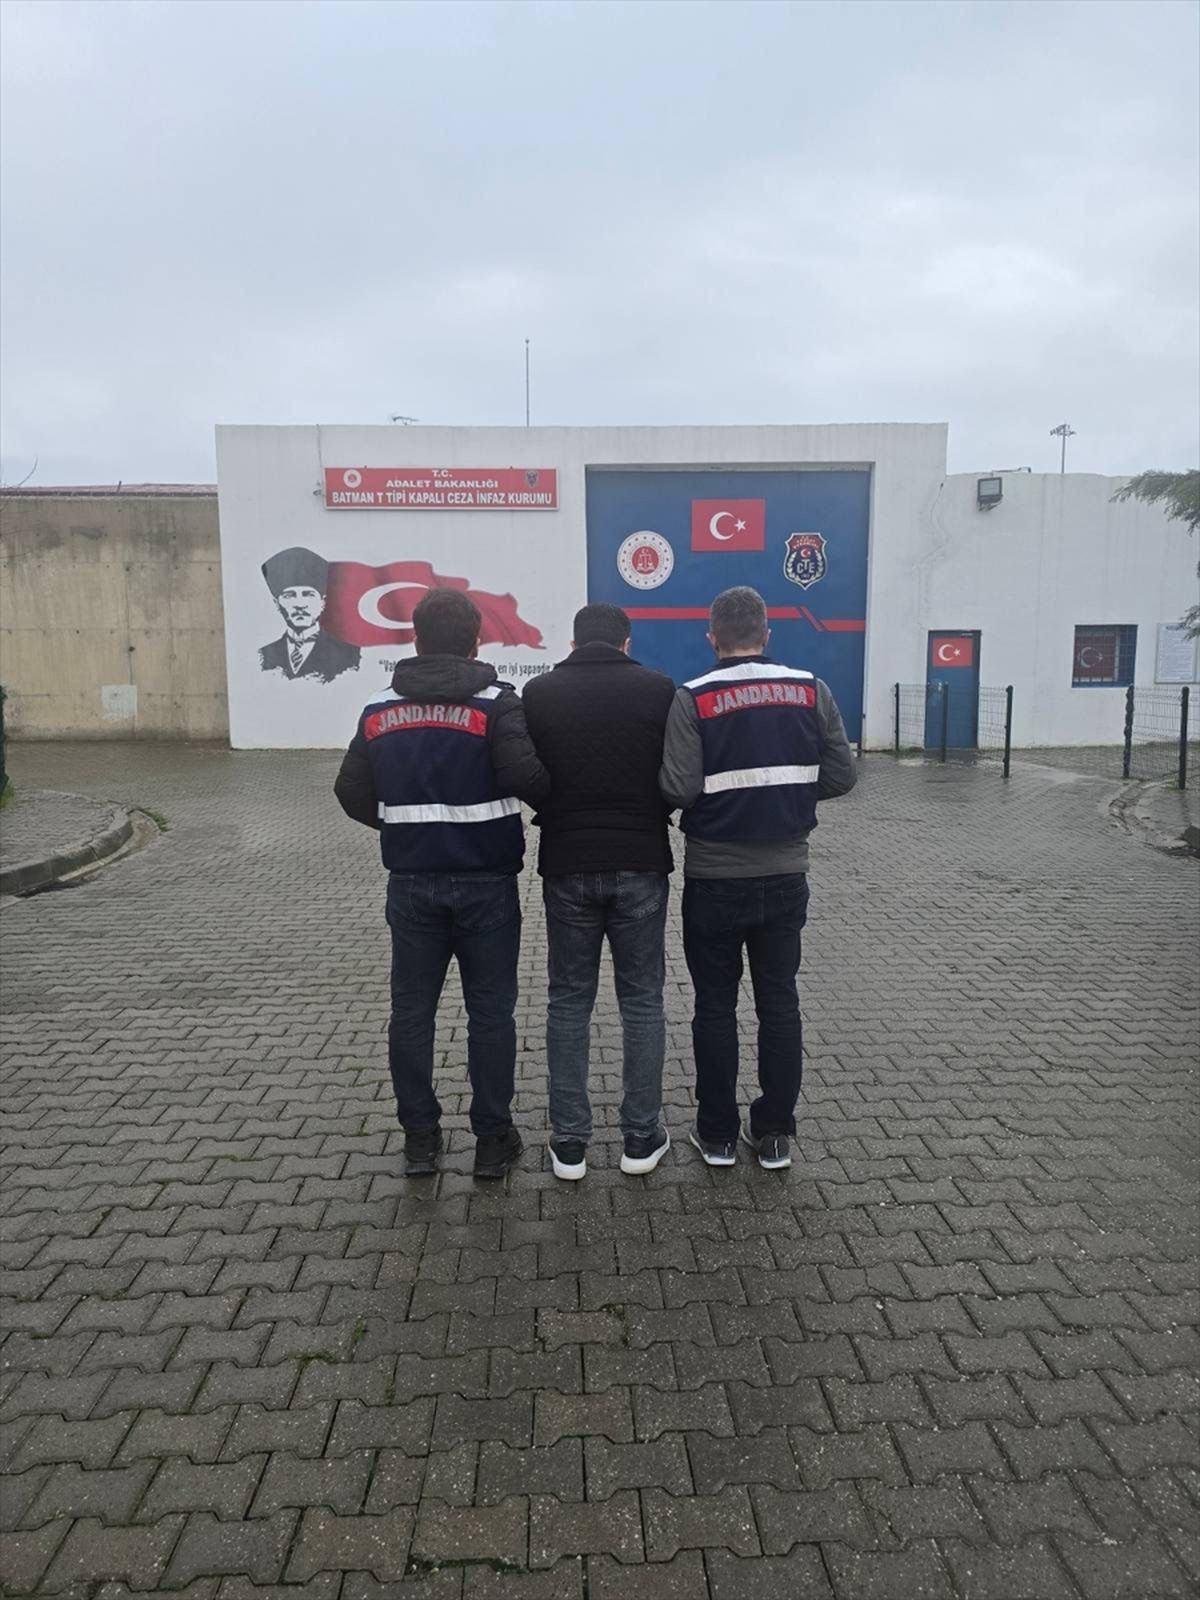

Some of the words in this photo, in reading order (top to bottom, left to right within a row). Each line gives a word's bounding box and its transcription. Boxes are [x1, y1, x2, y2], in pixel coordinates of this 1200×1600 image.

[432, 469, 453, 478] T.C.
[386, 479, 431, 488] ADALET
[434, 478, 499, 488] BAKANLIĞI
[332, 491, 374, 504] BATMAN
[377, 491, 384, 504] T
[386, 489, 406, 504] TİPİ
[409, 491, 445, 504] KAPALI
[447, 492, 474, 504] CEZA
[476, 489, 506, 504] İNFAZ
[508, 492, 552, 504] KURUMU
[713, 683, 808, 714] JANDARMA
[378, 704, 472, 732] JANDARMA
